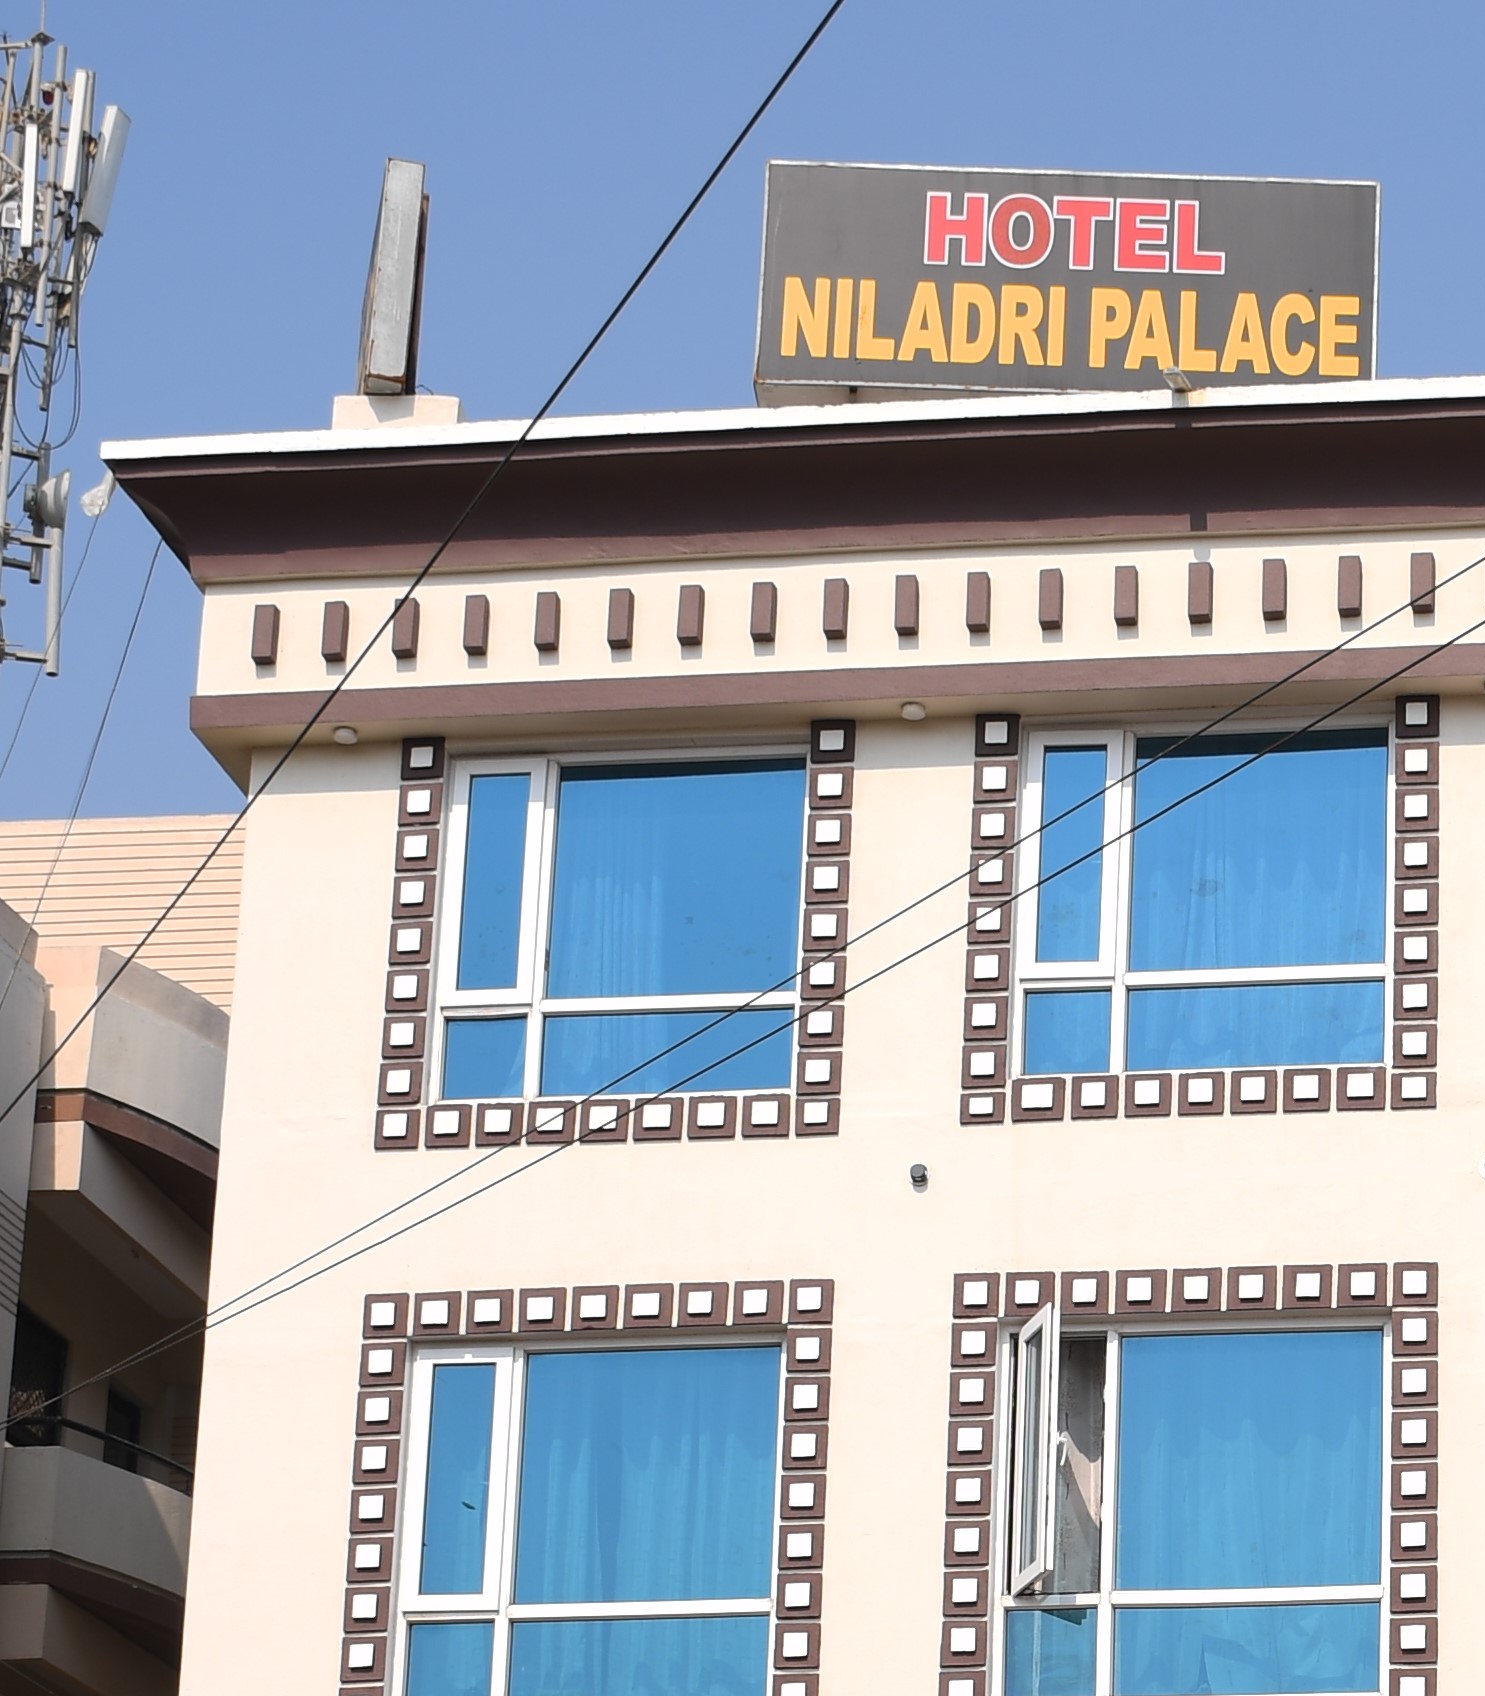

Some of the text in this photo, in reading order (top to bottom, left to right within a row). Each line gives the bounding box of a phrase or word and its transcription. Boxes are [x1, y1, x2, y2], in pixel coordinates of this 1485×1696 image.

[922, 190, 1226, 276] HOTEL
[779, 275, 1361, 377] NILADRI PALACE
